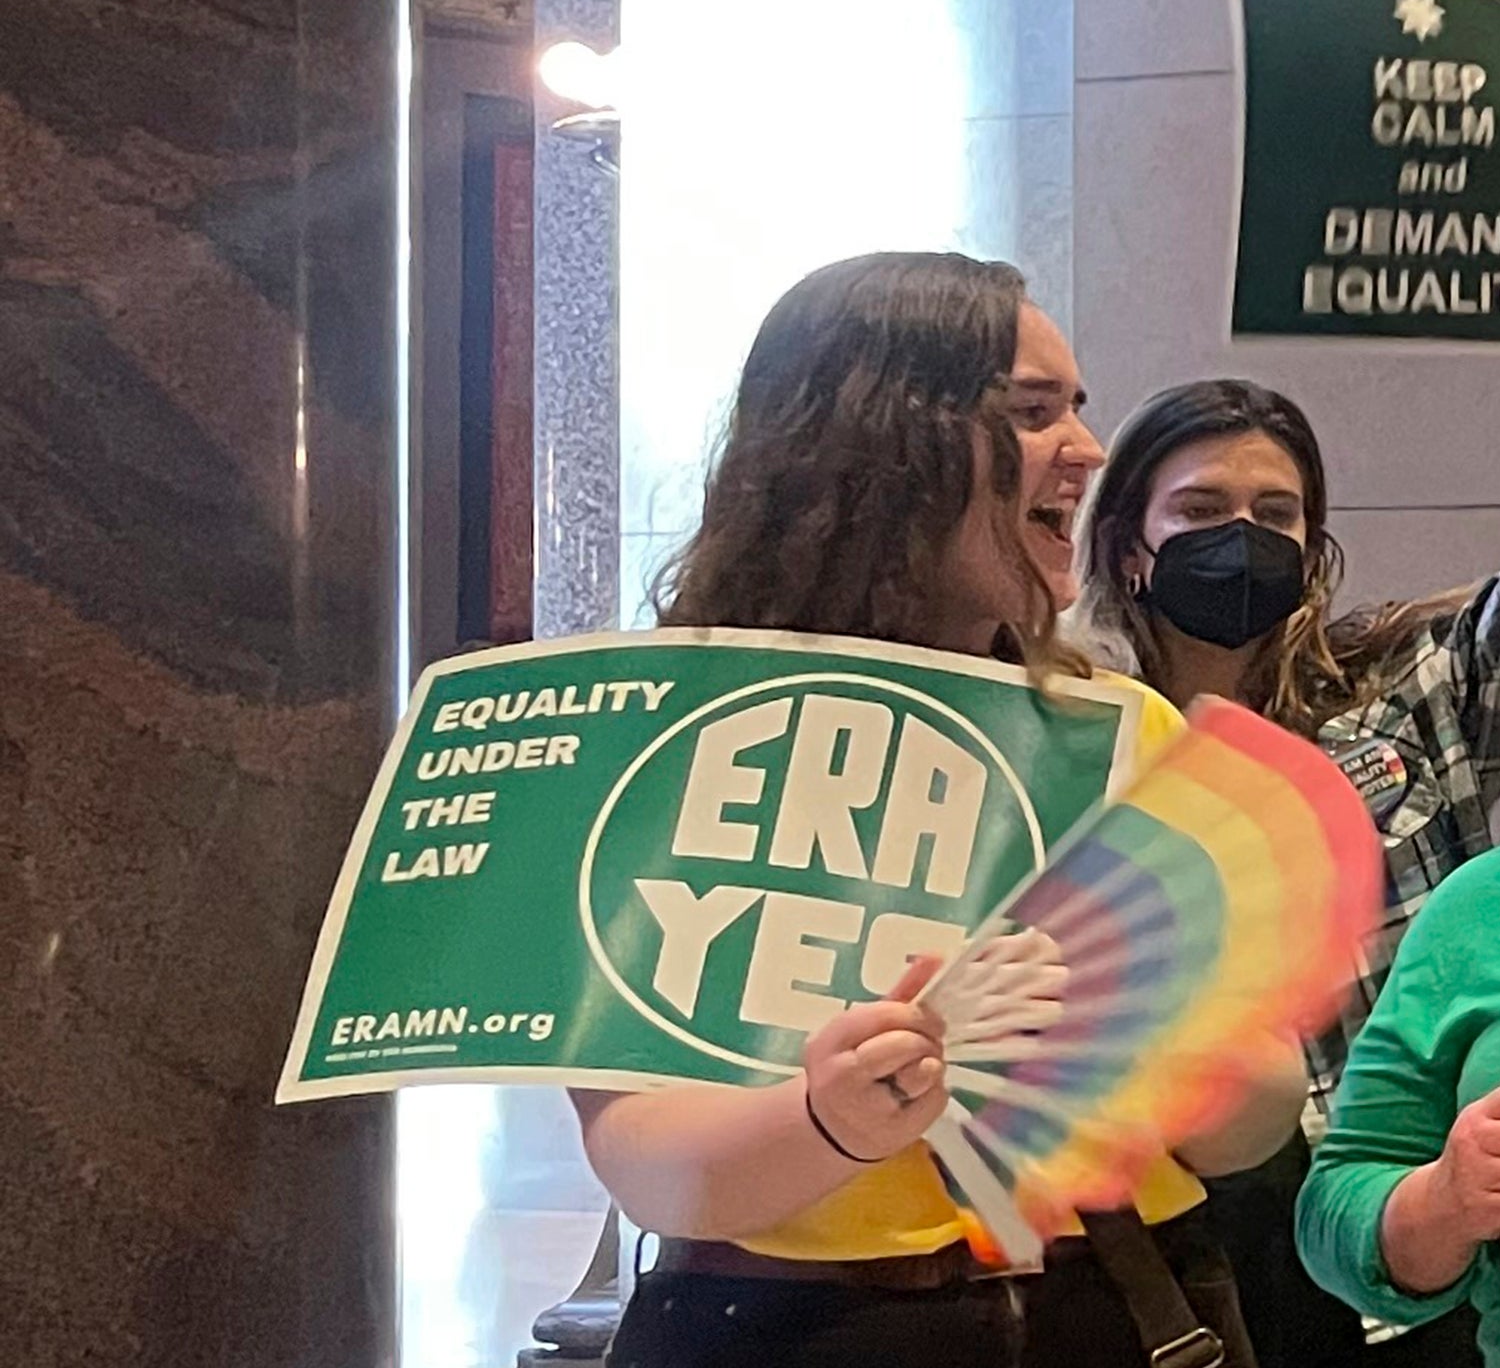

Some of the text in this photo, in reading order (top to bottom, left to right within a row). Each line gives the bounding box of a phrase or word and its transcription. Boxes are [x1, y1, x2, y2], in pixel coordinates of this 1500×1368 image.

[1373, 56, 1486, 103] KEEP
[1371, 104, 1495, 149] CALM
[1398, 157, 1468, 196] and
[432, 681, 676, 733] EQUALITY
[416, 735, 581, 781] UNDER
[401, 791, 497, 831] THE
[671, 693, 988, 899] ERA
[381, 842, 490, 883] LAW
[330, 1006, 556, 1046] ERAMN.org
